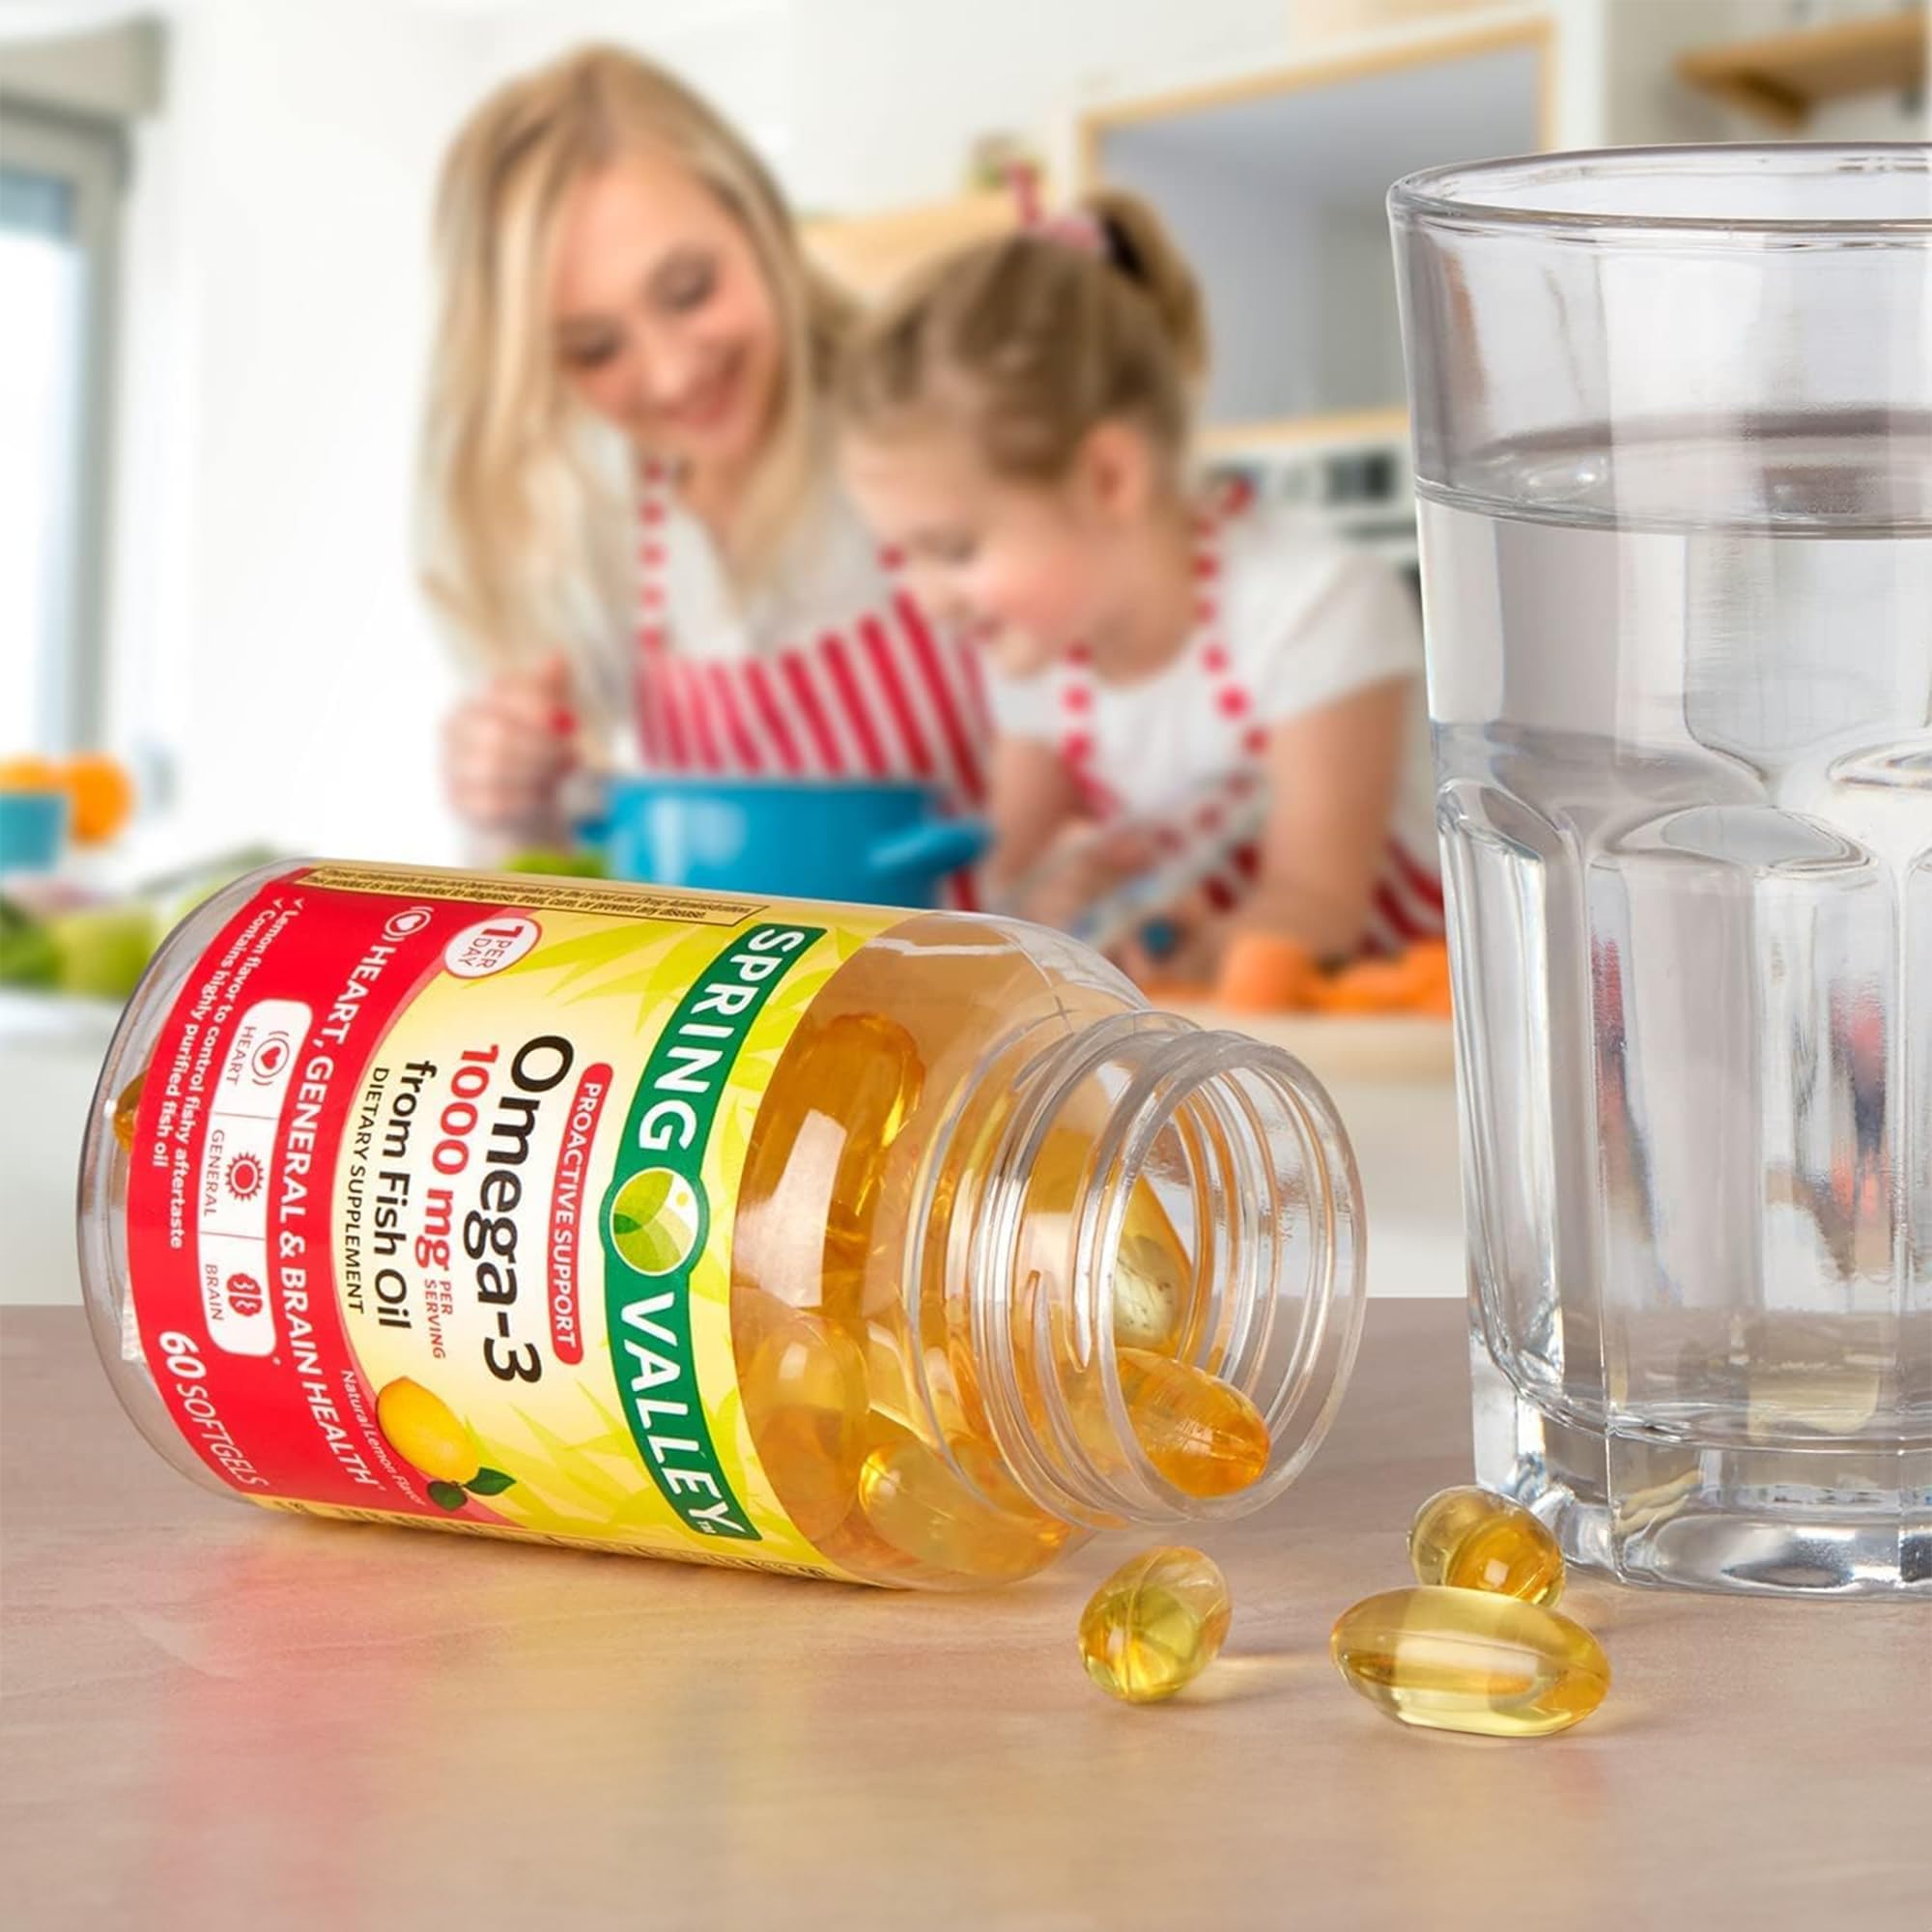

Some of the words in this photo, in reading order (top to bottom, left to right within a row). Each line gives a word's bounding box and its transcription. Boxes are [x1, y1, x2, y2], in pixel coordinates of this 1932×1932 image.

[220, 909, 276, 966] Contains
[256, 909, 298, 953] Lemon
[459, 937, 492, 967] DAY
[476, 939, 513, 968] PER
[482, 925, 525, 938] 1
[191, 969, 231, 1020] highly
[213, 1004, 234, 1023] to
[225, 955, 263, 1002] flavor
[313, 945, 396, 1048] HEART,
[165, 1024, 199, 1096] purified
[189, 1027, 220, 1091] control
[226, 1026, 257, 1086] HEART
[639, 928, 805, 1151] SPRING
[156, 1100, 178, 1137] fish
[175, 1096, 201, 1144] fishy
[280, 1056, 333, 1223] GENERAL
[354, 1066, 389, 1160] DIETARY
[382, 1061, 438, 1158] from
[432, 1043, 499, 1176] 1000
[153, 1145, 169, 1167] oil
[203, 1128, 225, 1216] GENERAL
[554, 1082, 604, 1224] PROACTIVE
[170, 1148, 191, 1249] aftertaste
[374, 1171, 411, 1256] Fish
[414, 1188, 454, 1271] mg
[464, 1035, 574, 1383] Omega-3
[279, 1232, 305, 1258] &
[345, 1164, 365, 1314] SUPPLEMENT
[205, 1264, 224, 1321] BRAIN
[281, 1267, 323, 1376] BRAIN
[374, 1268, 412, 1329] Oil
[424, 1278, 446, 1359] SERVING
[439, 1280, 453, 1315] PER
[554, 1230, 577, 1349] SUPPORT
[159, 1331, 207, 1378] 60
[177, 1383, 270, 1486] SOFTGELS
[341, 1370, 374, 1427] Natural
[364, 1429, 397, 1476] Lemon
